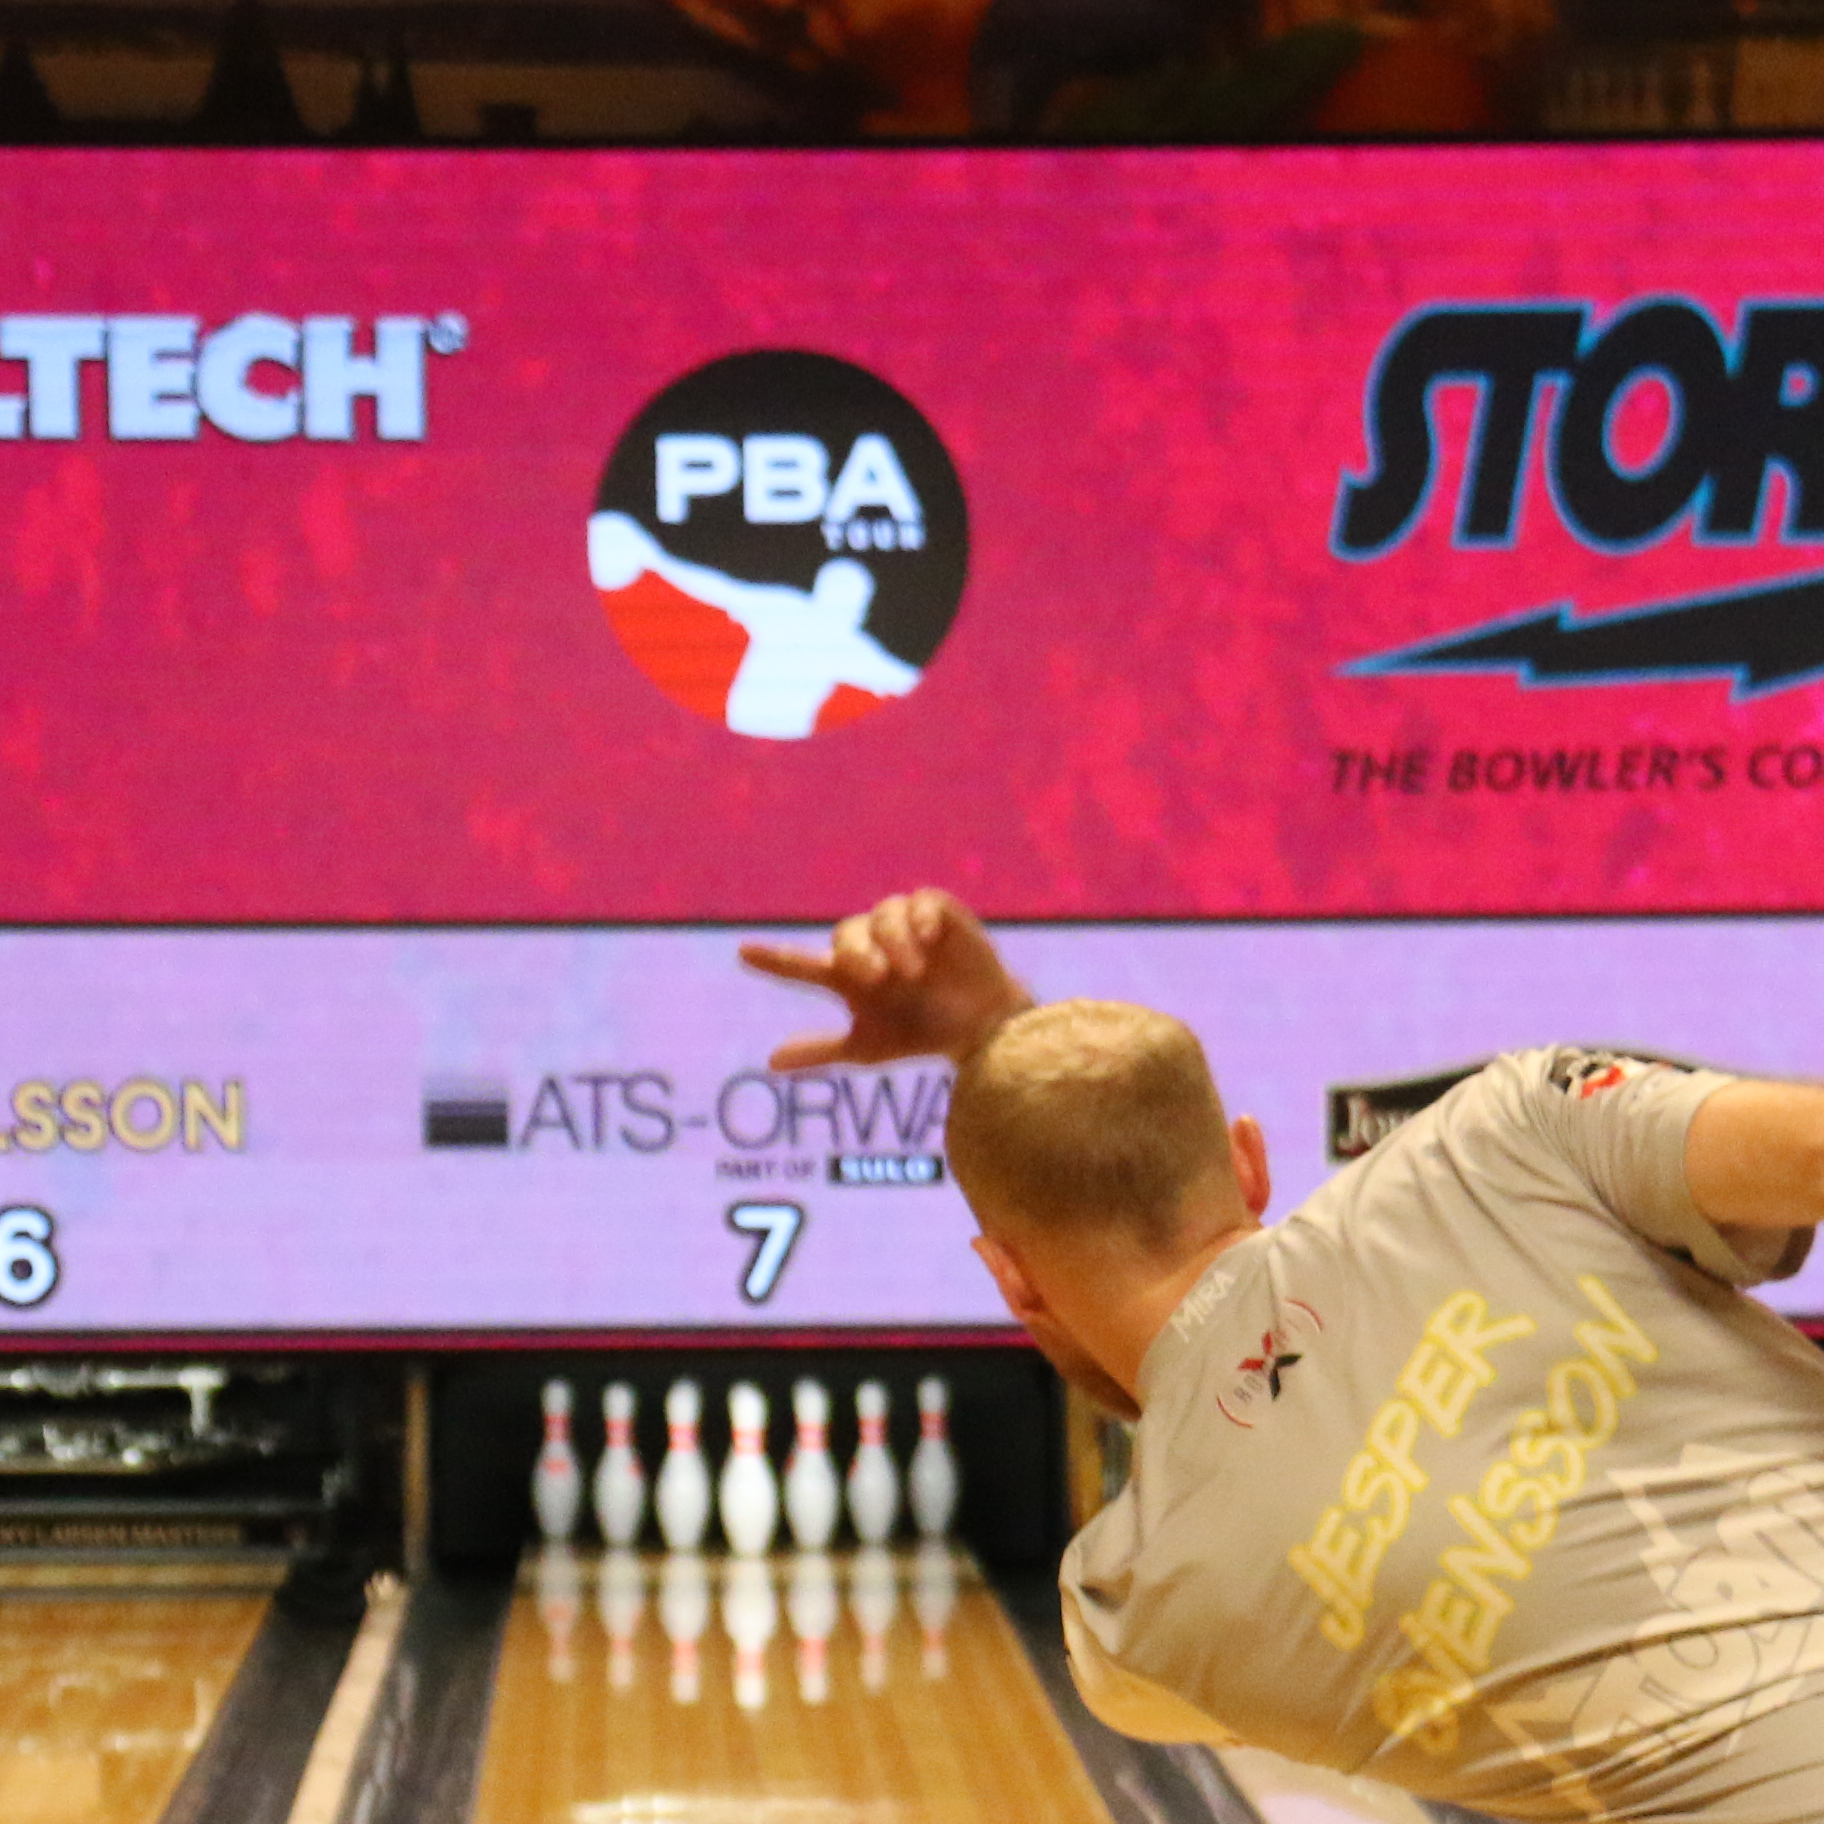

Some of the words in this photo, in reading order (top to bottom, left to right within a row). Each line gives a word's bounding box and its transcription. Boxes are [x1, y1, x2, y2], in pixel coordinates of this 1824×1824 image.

[654, 431, 924, 526] PBA
[1329, 748, 1434, 795] THE
[1445, 745, 1730, 792] BOWLER'S
[724, 1200, 806, 1306] 7
[1287, 1289, 1539, 1652] JESPER
